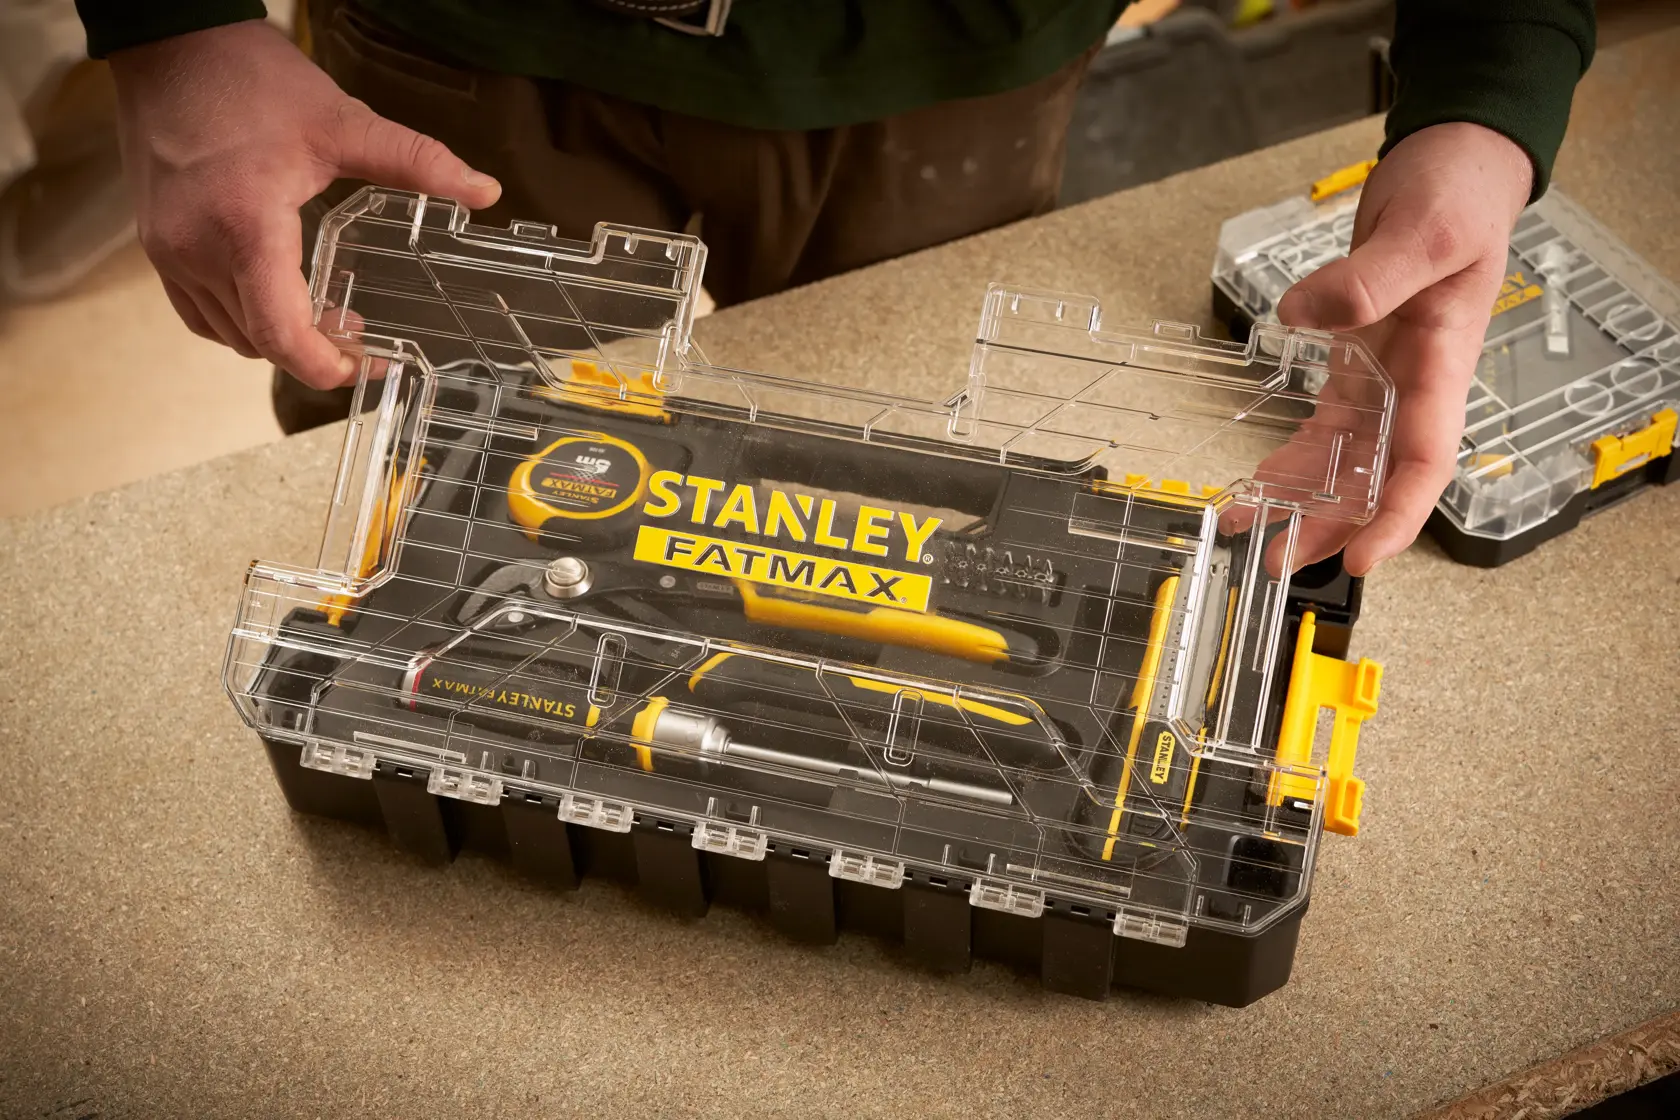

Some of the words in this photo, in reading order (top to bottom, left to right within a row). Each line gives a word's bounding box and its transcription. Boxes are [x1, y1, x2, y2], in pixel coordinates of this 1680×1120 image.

[575, 454, 611, 474] 5m
[549, 478, 614, 497] FATMAX
[497, 690, 576, 719] STANLEY
